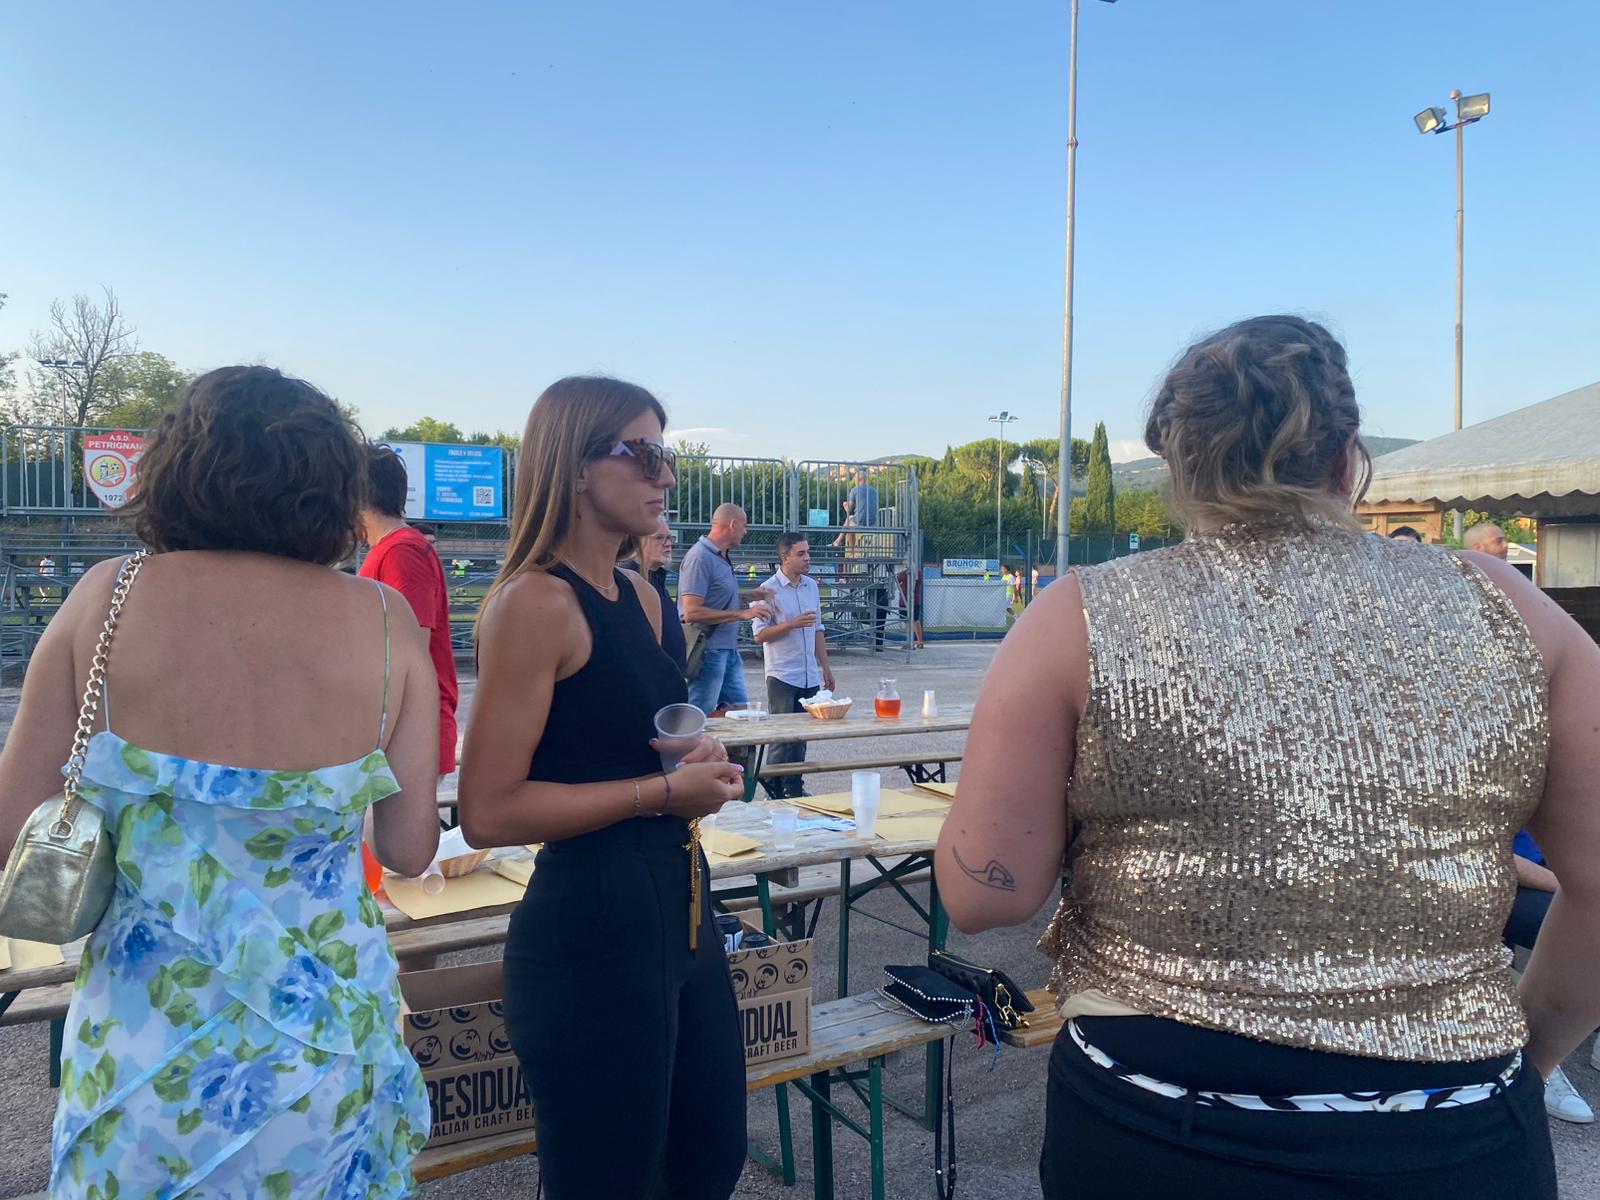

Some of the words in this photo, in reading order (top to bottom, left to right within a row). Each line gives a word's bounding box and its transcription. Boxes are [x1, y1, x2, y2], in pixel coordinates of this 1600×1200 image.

[774, 1038, 797, 1054] BEER
[426, 1066, 532, 1124] RESIDUA
[474, 1110, 511, 1130] CRAFT
